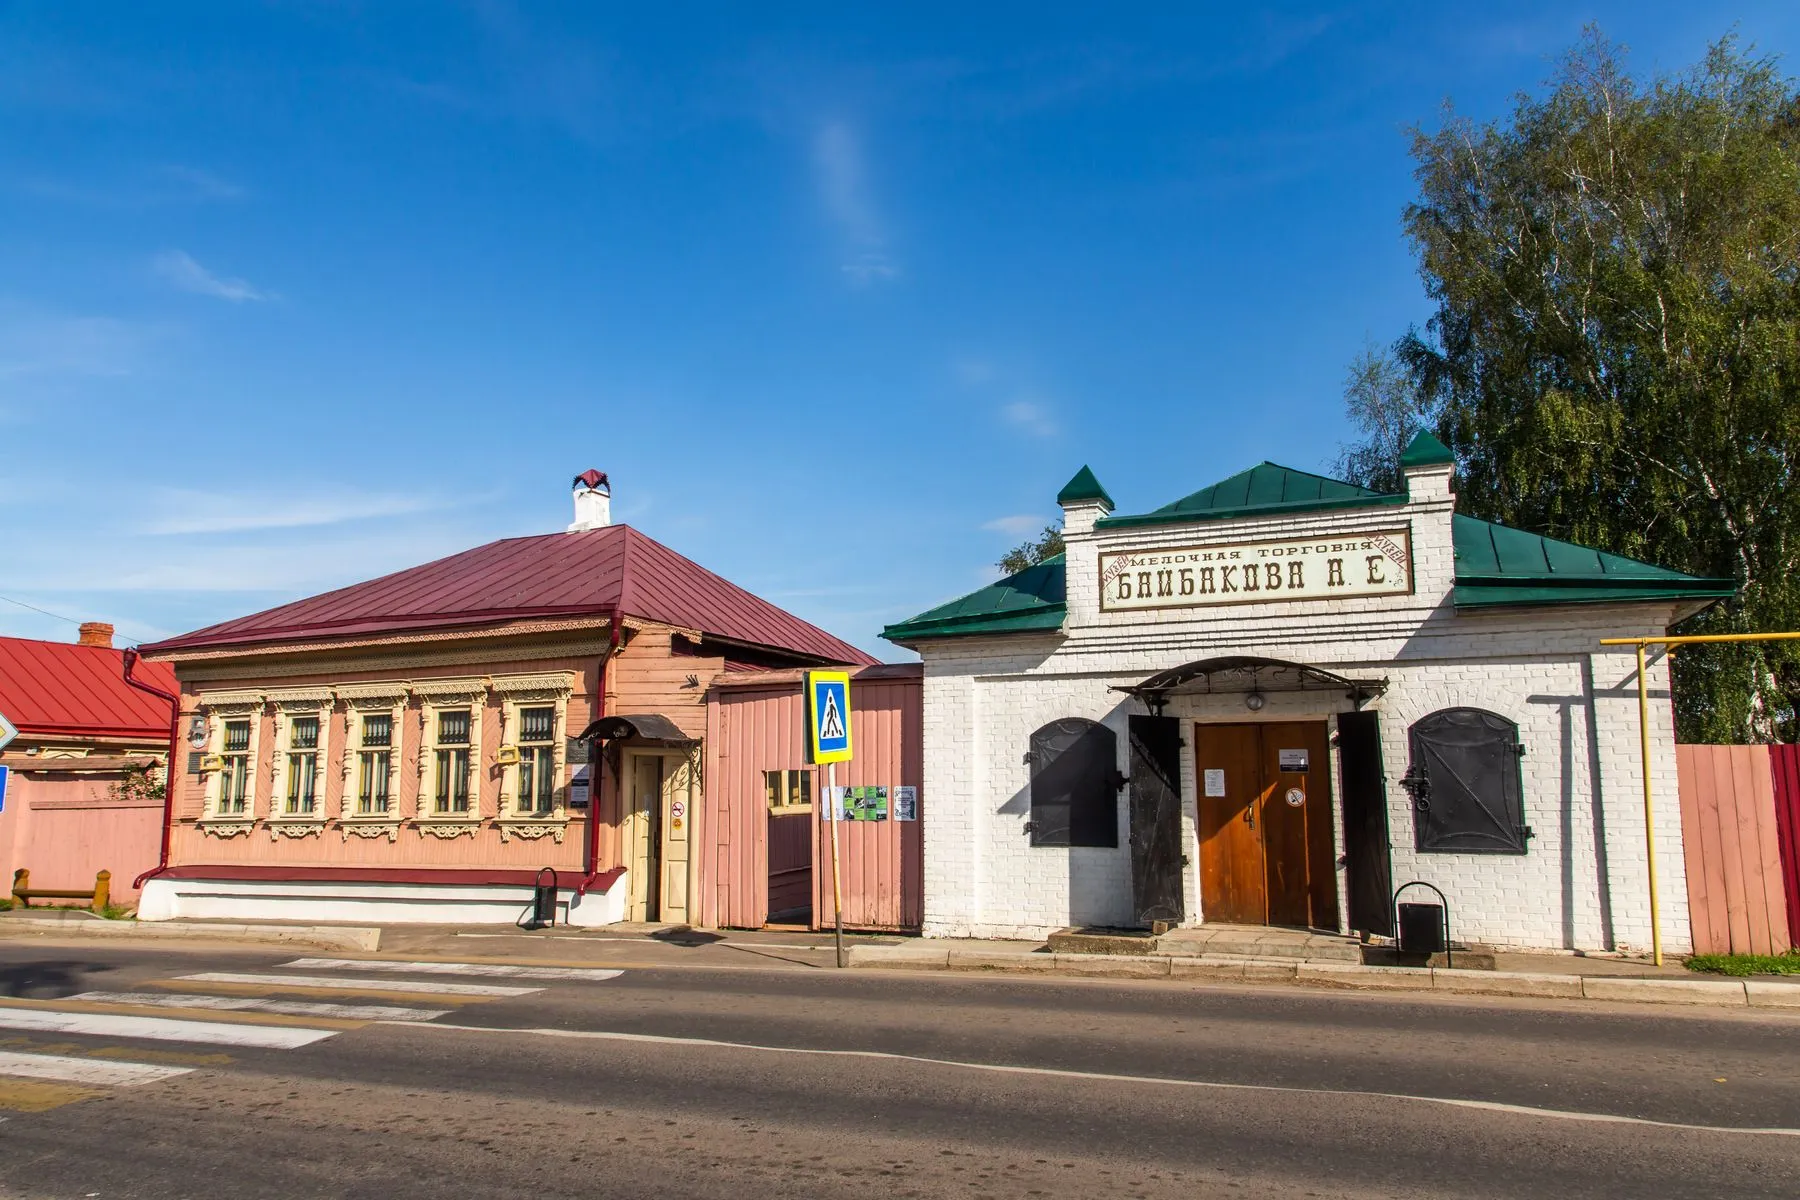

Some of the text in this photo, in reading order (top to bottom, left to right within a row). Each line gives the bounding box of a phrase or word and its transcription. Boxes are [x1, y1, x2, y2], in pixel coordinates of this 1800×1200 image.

[1130, 541, 1373, 567] МЕЛОЧНАЯ ТОРГОВЛЯ
[1116, 555, 1392, 600] БАЙБАКОВА А. Е.
